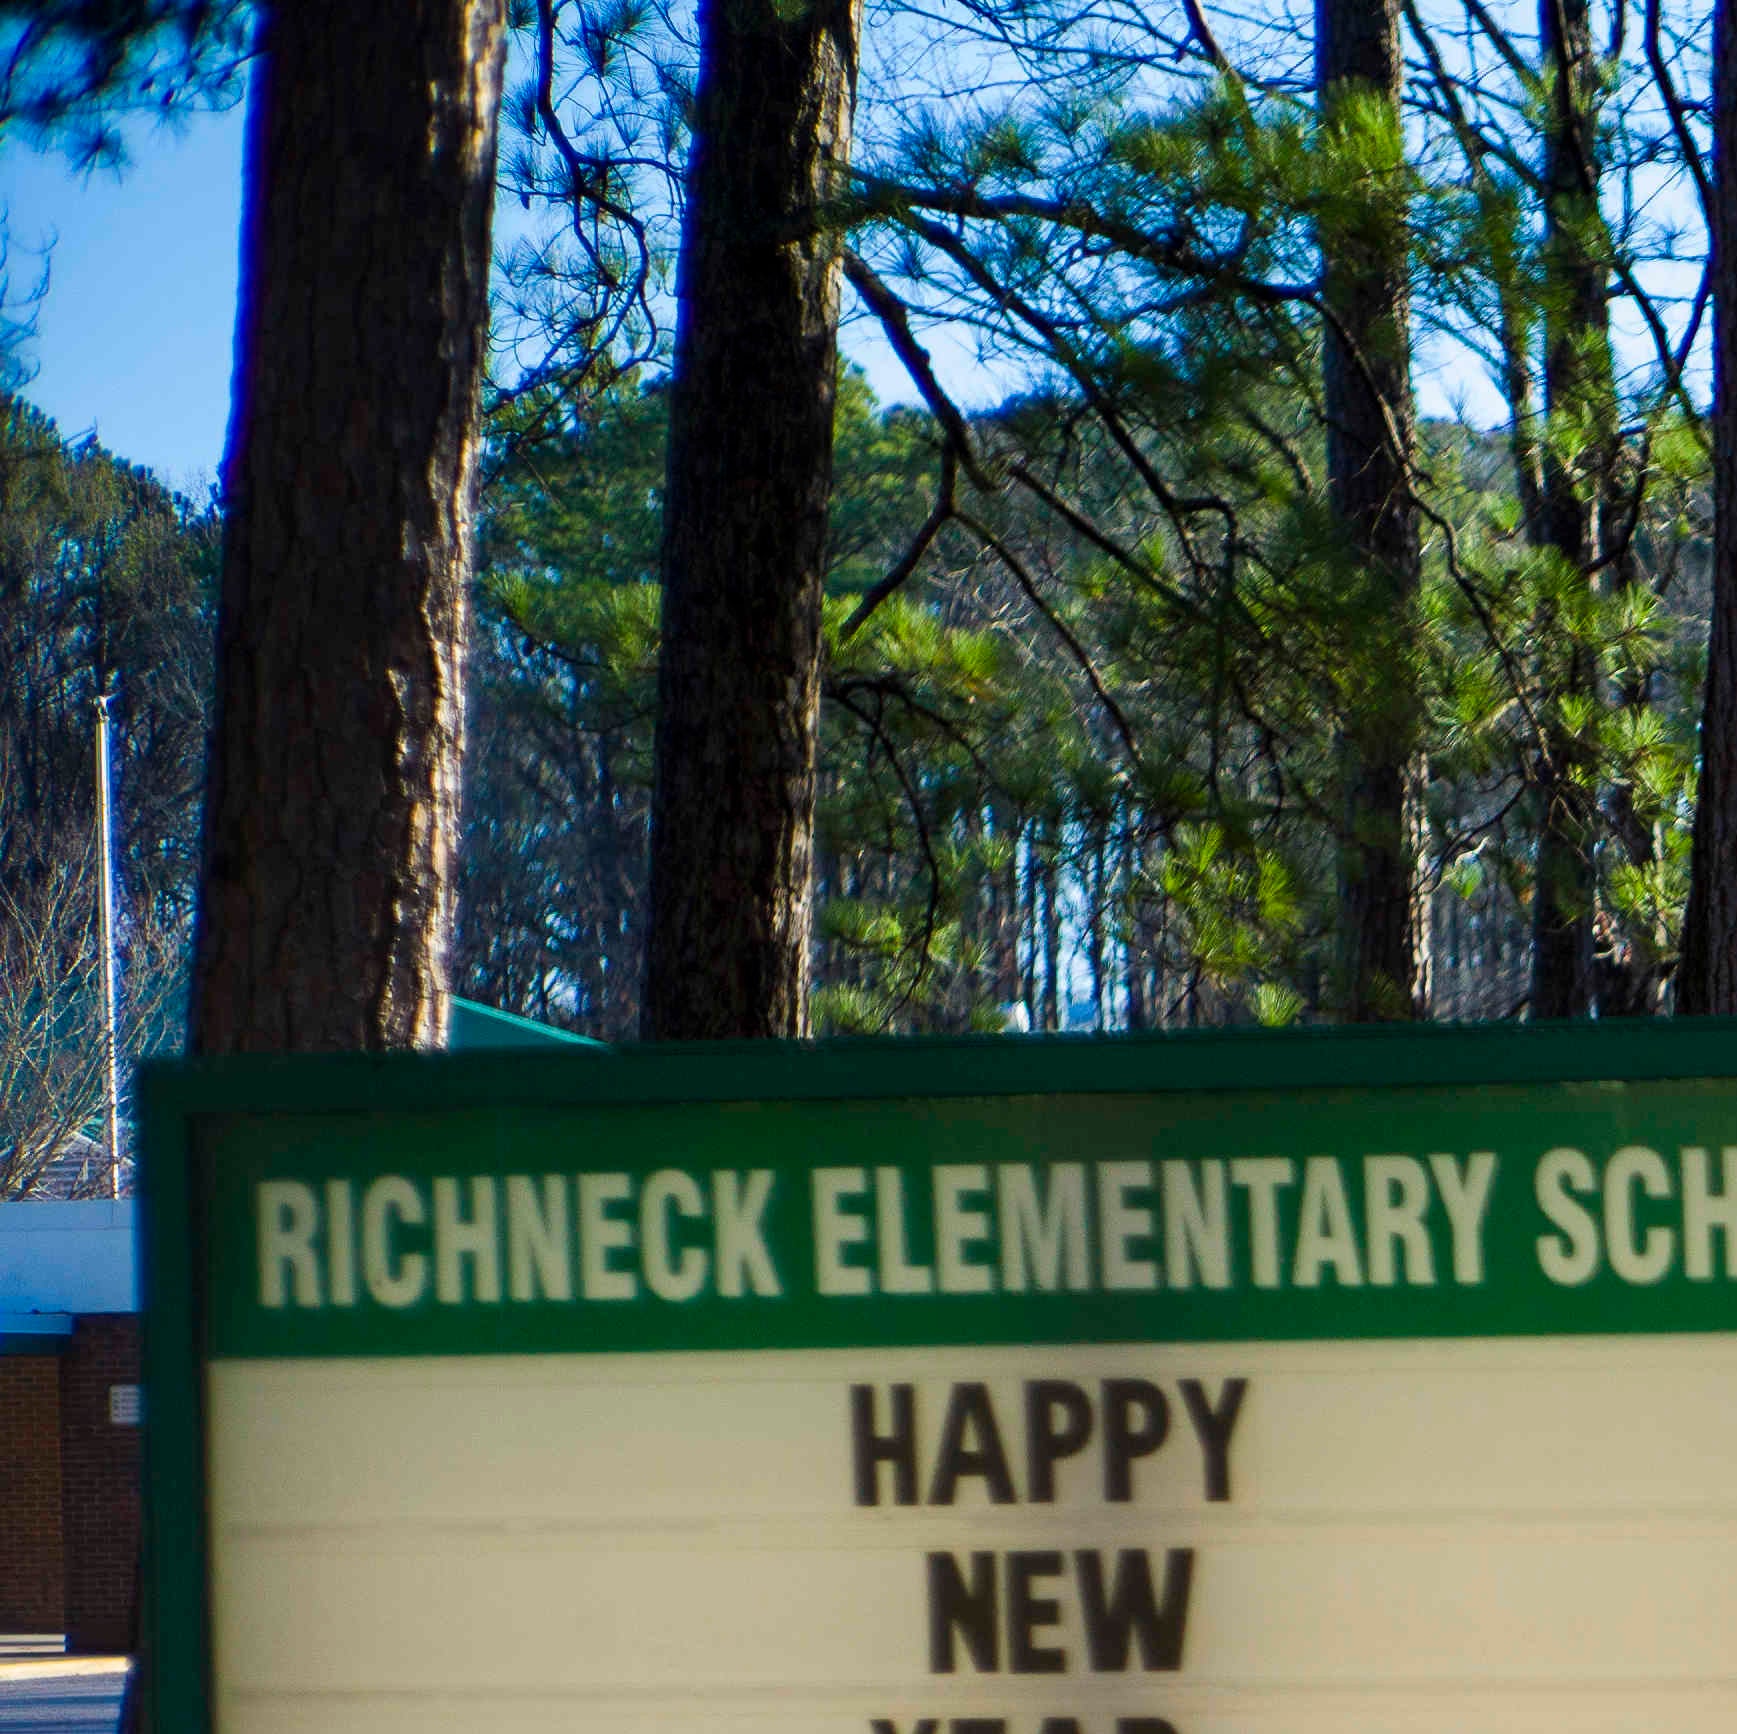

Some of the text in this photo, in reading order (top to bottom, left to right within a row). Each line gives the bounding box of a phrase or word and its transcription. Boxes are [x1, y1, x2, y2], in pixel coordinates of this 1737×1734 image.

[256, 1168, 784, 1309] RICHNECK
[811, 1151, 1496, 1297] ELEMENTARY
[849, 1378, 1248, 1506] HAPPY
[927, 1547, 1196, 1675] NEW
